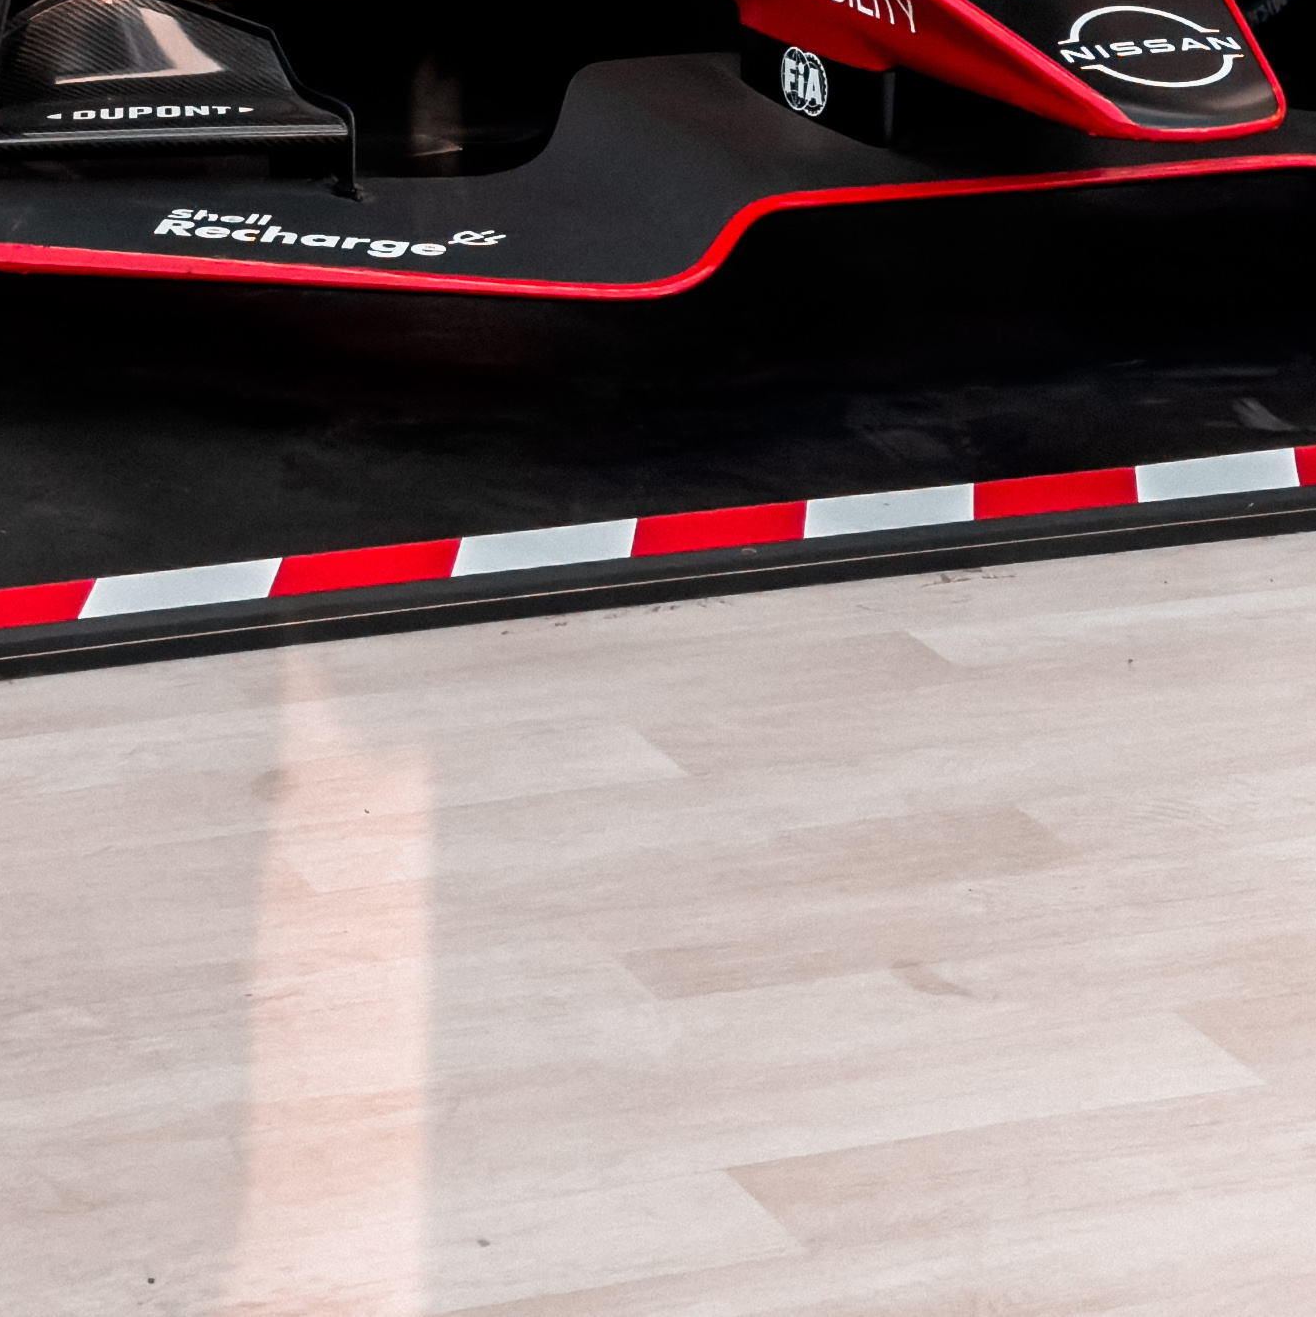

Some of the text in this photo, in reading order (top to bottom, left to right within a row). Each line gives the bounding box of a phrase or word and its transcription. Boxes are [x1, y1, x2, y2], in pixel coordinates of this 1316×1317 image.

[1060, 34, 1242, 63] NISSAN
[72, 105, 233, 120] DUPONT
[166, 208, 273, 227] Shell
[154, 218, 449, 258] Recharge
